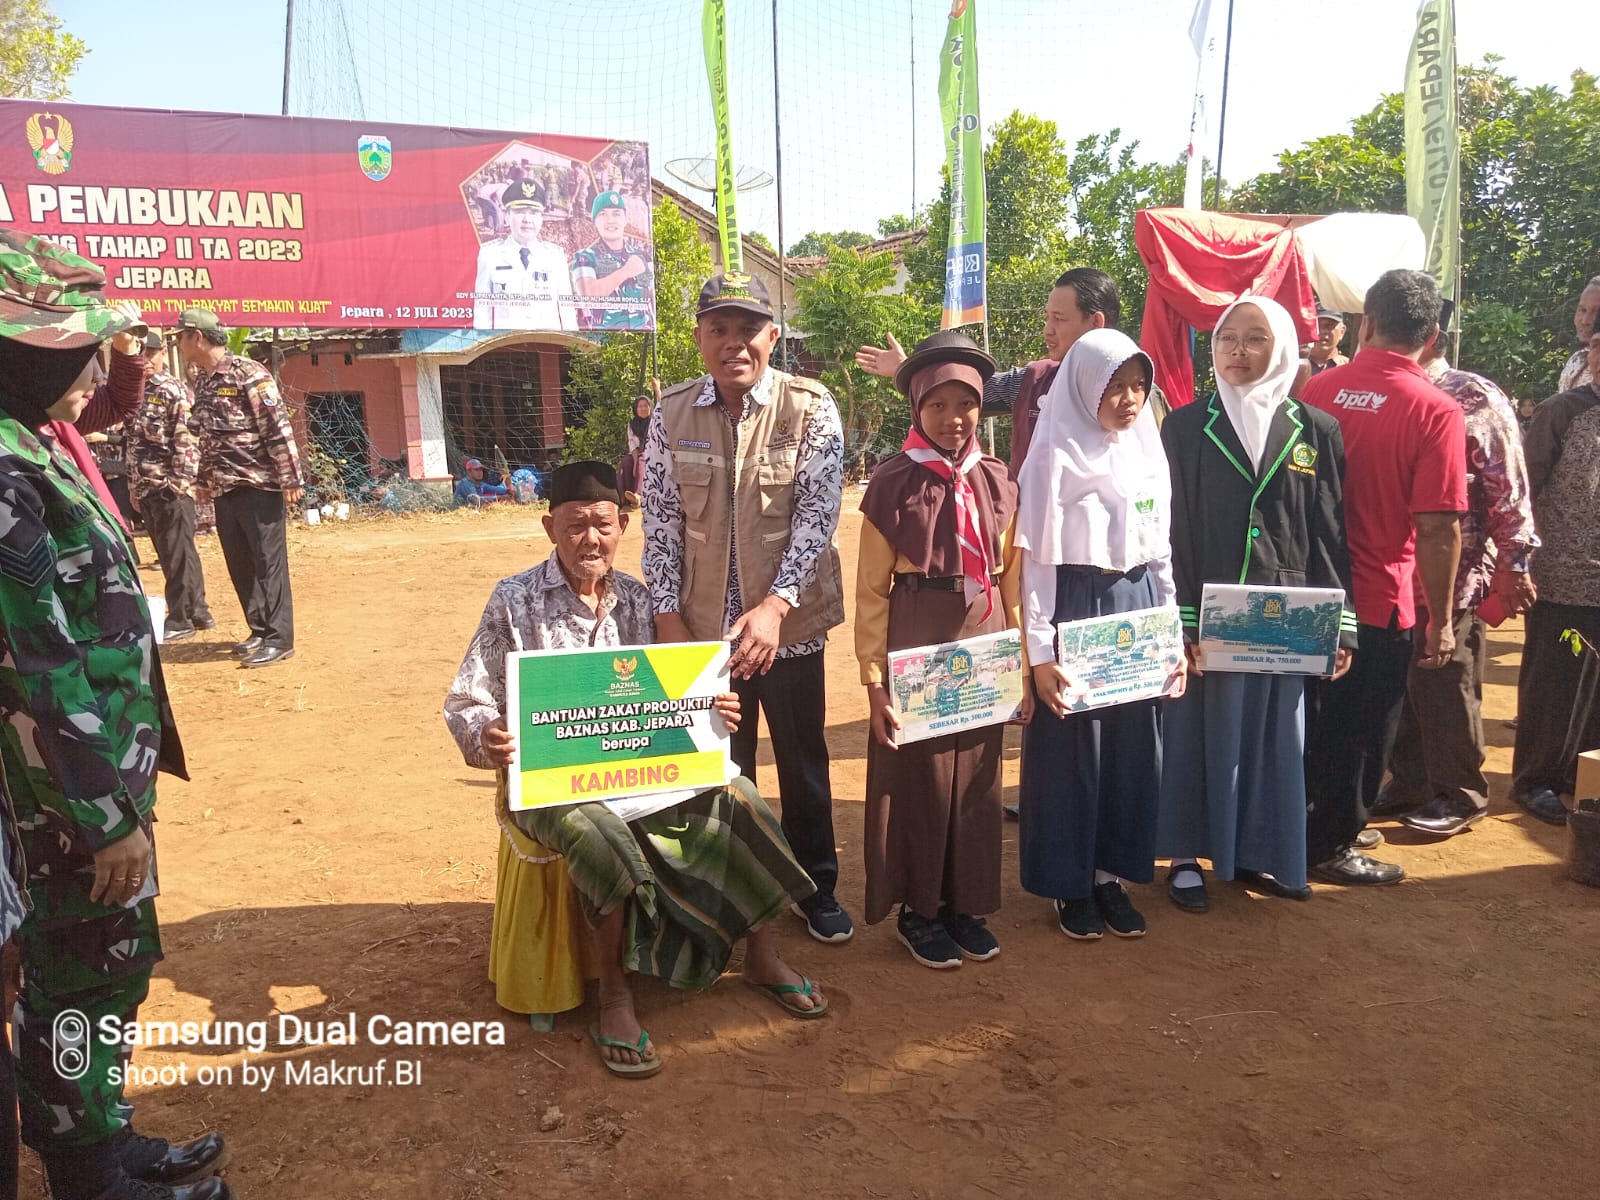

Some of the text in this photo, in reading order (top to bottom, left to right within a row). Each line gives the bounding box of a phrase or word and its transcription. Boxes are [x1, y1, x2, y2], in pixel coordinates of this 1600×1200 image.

[27, 184, 304, 229] PEMBUKAAN
[85, 235, 167, 259] TAHAP
[175, 237, 193, 259] II
[199, 238, 232, 260] TA
[238, 239, 303, 262] 2023
[115, 266, 213, 290] JEPARA
[241, 300, 295, 313] SEMAKIN
[340, 306, 384, 319] Jepara
[395, 307, 411, 318] 12
[413, 307, 438, 319] JULI
[441, 307, 473, 319] 2023
[610, 681, 640, 690] BAZNAS
[531, 696, 715, 725] BANTUAN ZAKAT PRODUKTIF
[556, 714, 694, 739] BAZNAS KAB. JEPARA
[602, 736, 650, 751] berupa
[571, 763, 680, 794] KAMBING
